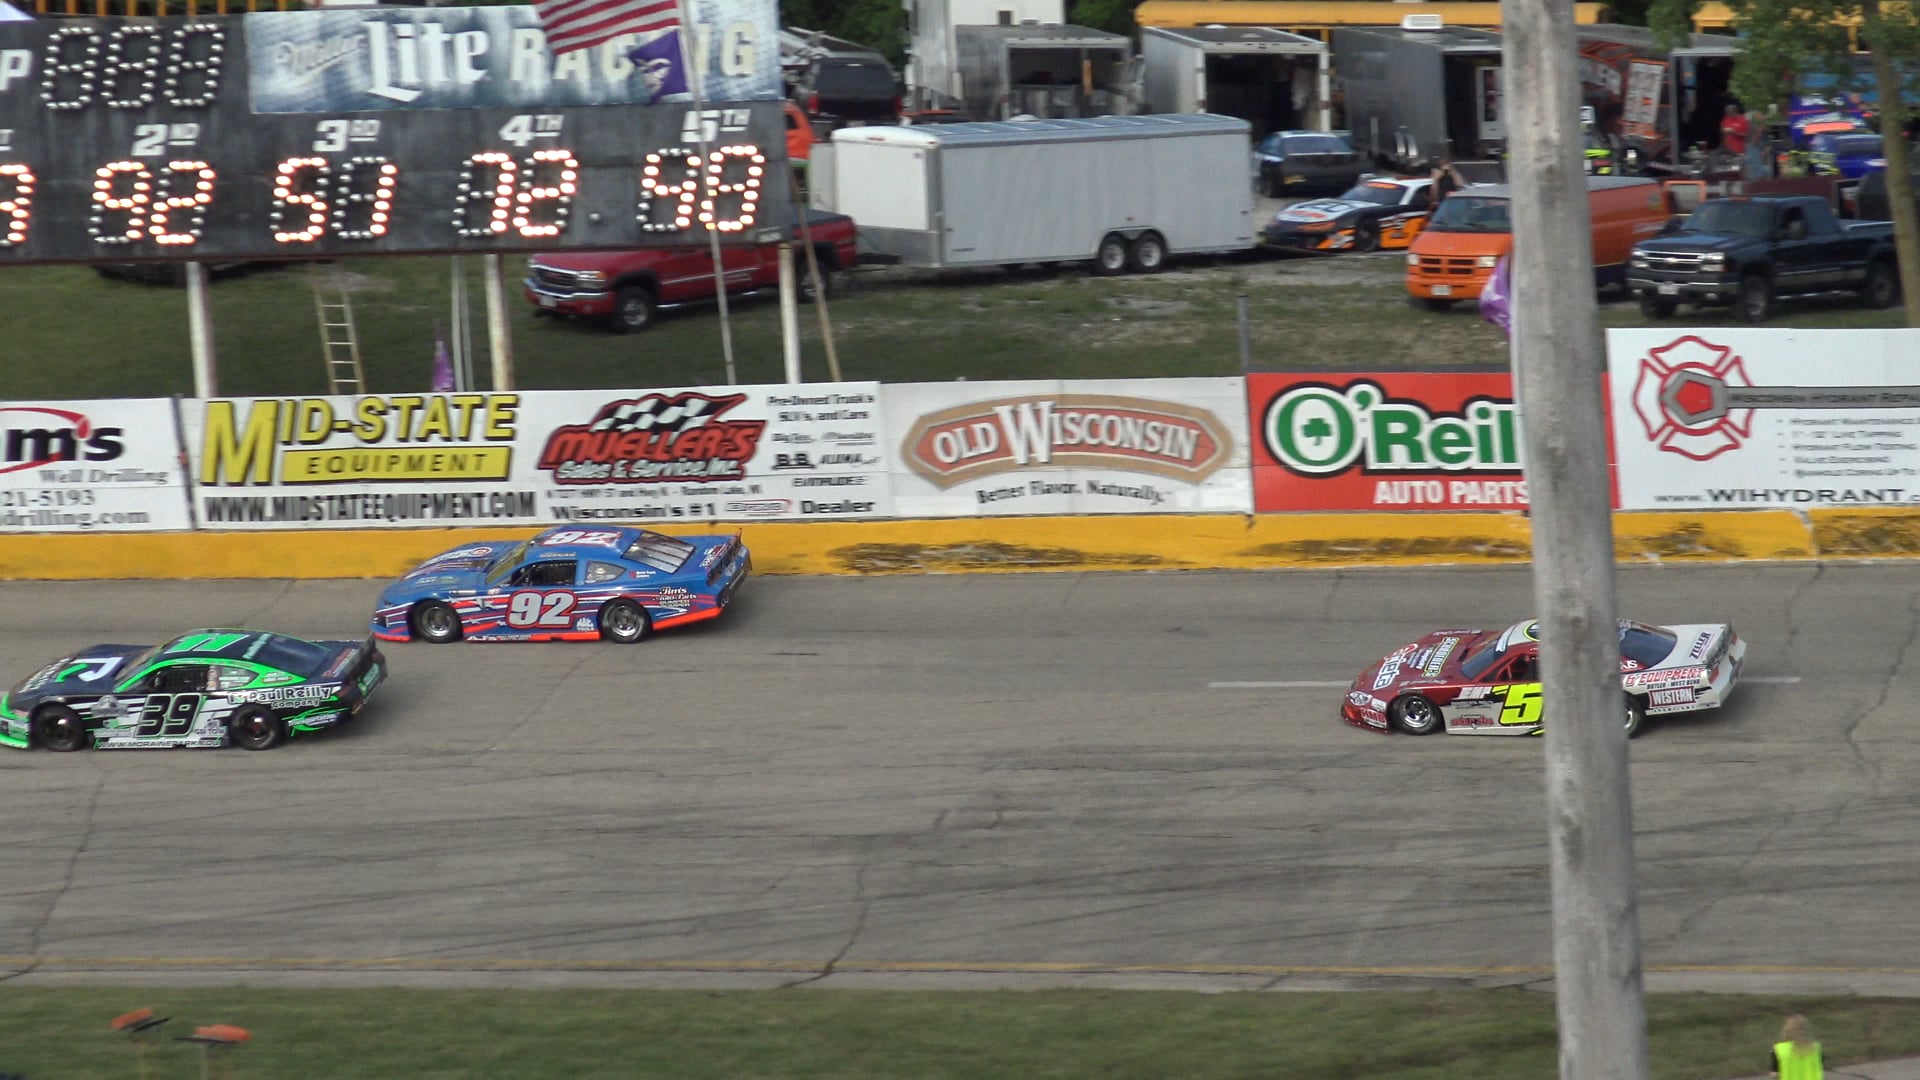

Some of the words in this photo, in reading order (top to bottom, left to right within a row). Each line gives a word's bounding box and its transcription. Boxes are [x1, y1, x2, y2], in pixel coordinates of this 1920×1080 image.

[360, 20, 489, 101] Lite
[509, 22, 757, 82] RACG
[313, 119, 382, 152] 3RD
[498, 114, 565, 147] 4TH
[681, 109, 752, 143] 5TH
[131, 123, 200, 156] 2ND
[92, 161, 217, 244] 92
[547, 426, 761, 463] MUELLER'S
[932, 421, 999, 465] OLD
[993, 400, 1203, 465] WISCONSIN
[90, 468, 169, 484] Drilling
[306, 453, 488, 475] EQUIPMENT
[557, 459, 612, 479] Sales
[1373, 480, 1444, 504] AUTO
[1450, 480, 1531, 504] PARTS
[203, 491, 537, 522] WWW.MIDSTATEEQUIPMENT.COM
[552, 504, 685, 520] Wisconsin's
[801, 500, 875, 514] Dealer
[541, 530, 620, 546] 92
[507, 591, 576, 627] 92
[1689, 632, 1711, 659] ZELLER
[1639, 666, 1706, 684] EQUIPMENT
[1670, 680, 1685, 688] WEST
[250, 690, 284, 702] Paul
[285, 686, 332, 699] Reilly
[271, 699, 321, 709] Company
[1653, 687, 1693, 705] WESTERN
[133, 692, 203, 737] 39
